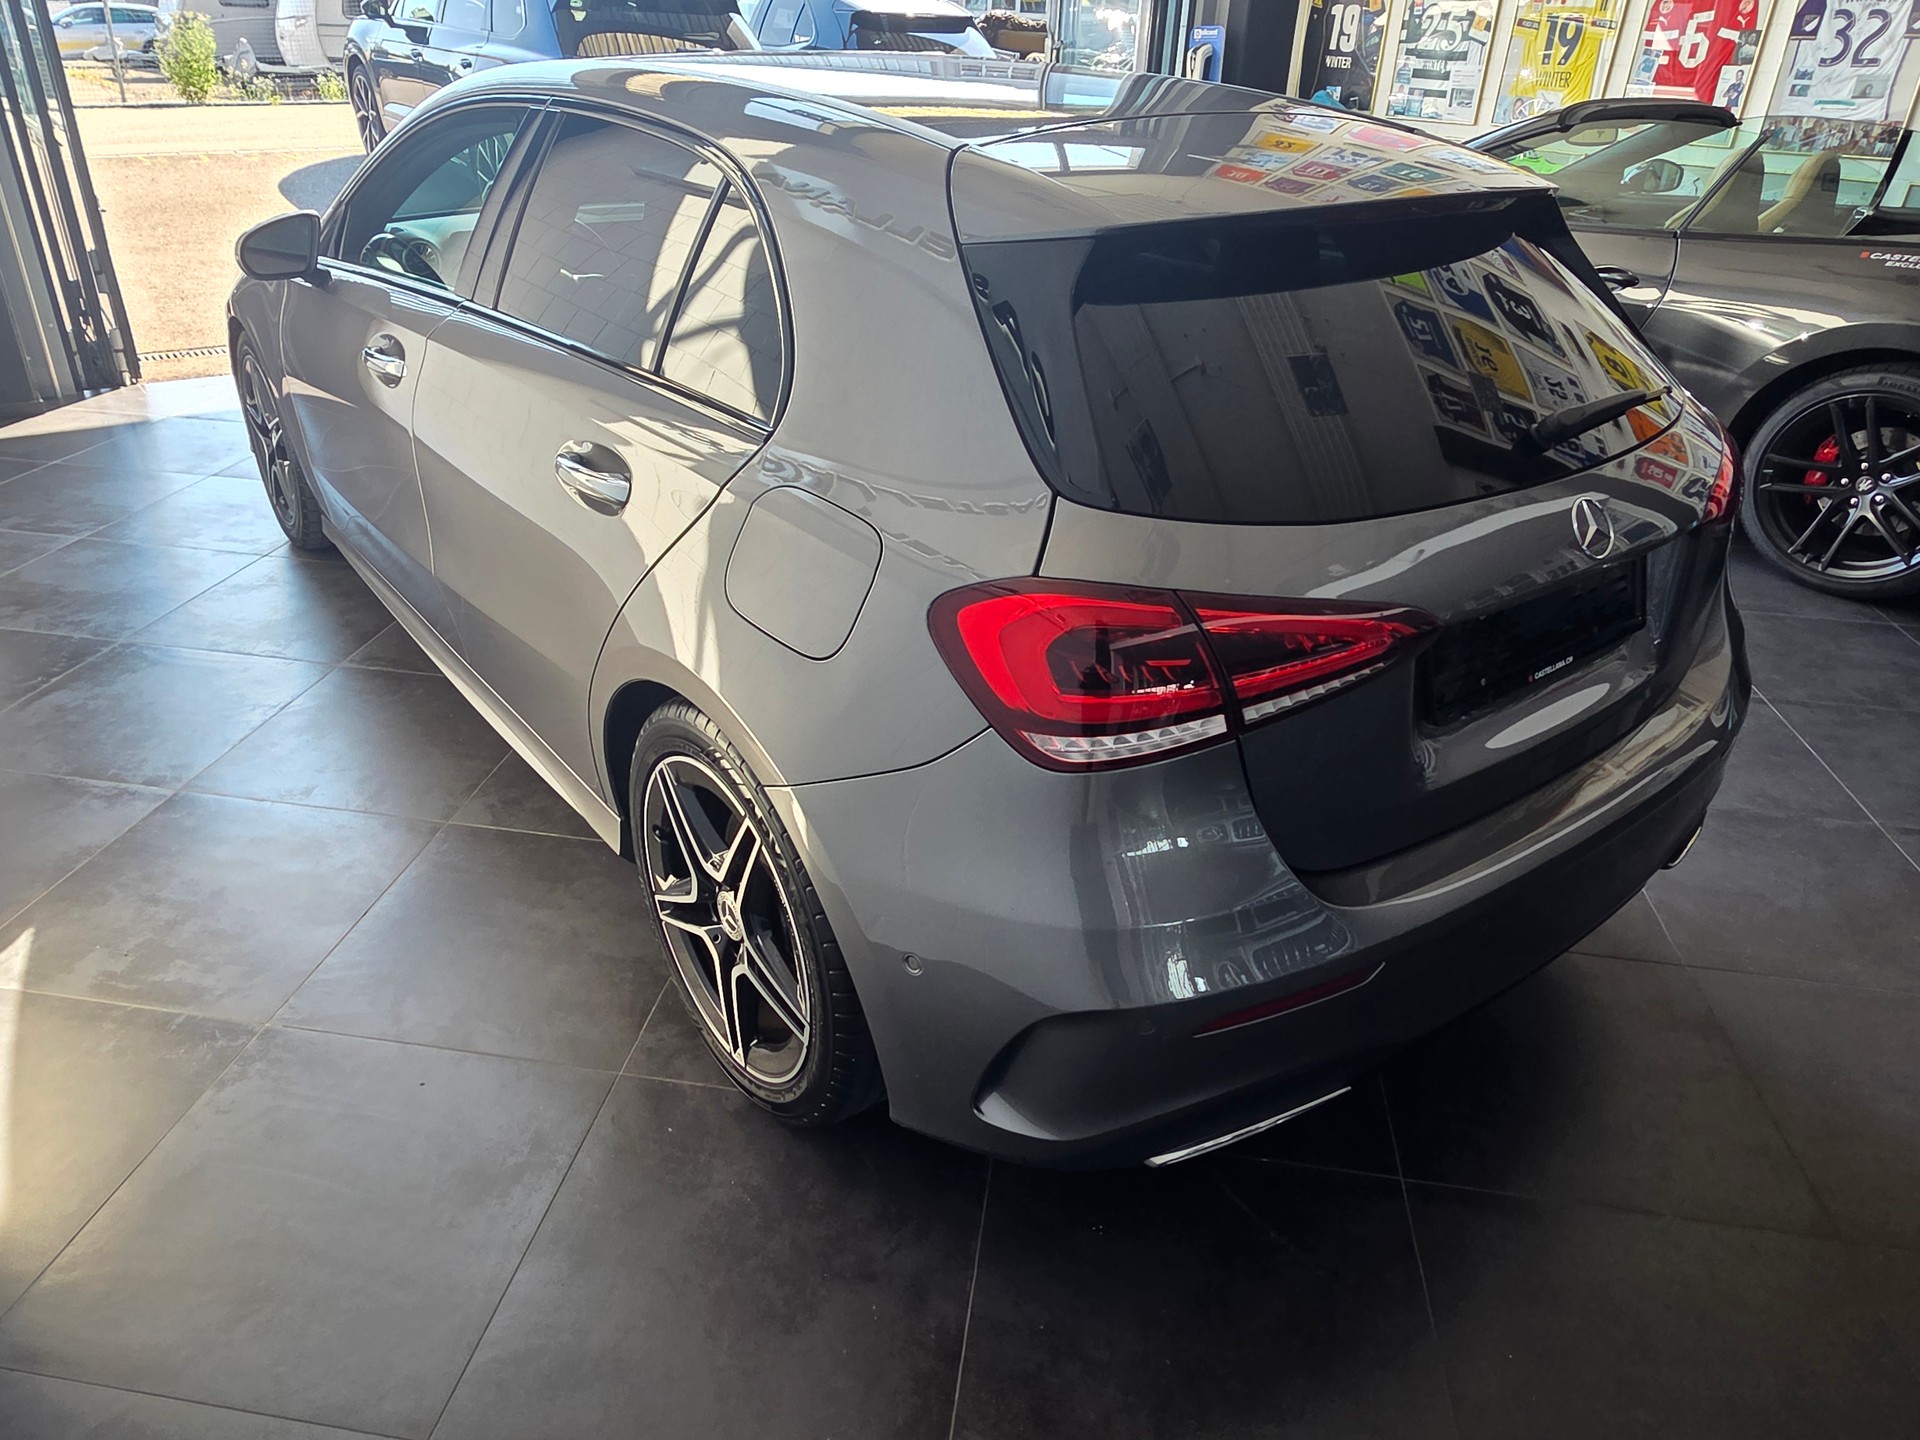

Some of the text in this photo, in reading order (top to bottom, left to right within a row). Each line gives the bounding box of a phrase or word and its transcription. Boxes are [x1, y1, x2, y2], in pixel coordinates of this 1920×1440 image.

[1329, 4, 1361, 52] 19
[1417, 4, 1468, 51] 25
[1541, 13, 1584, 66] 19
[1678, 10, 1715, 69] 6
[1818, 8, 1893, 68] 32
[1325, 55, 1352, 69] WINTER
[1535, 70, 1572, 88] WINTER
[1870, 252, 1920, 263] CASTE
